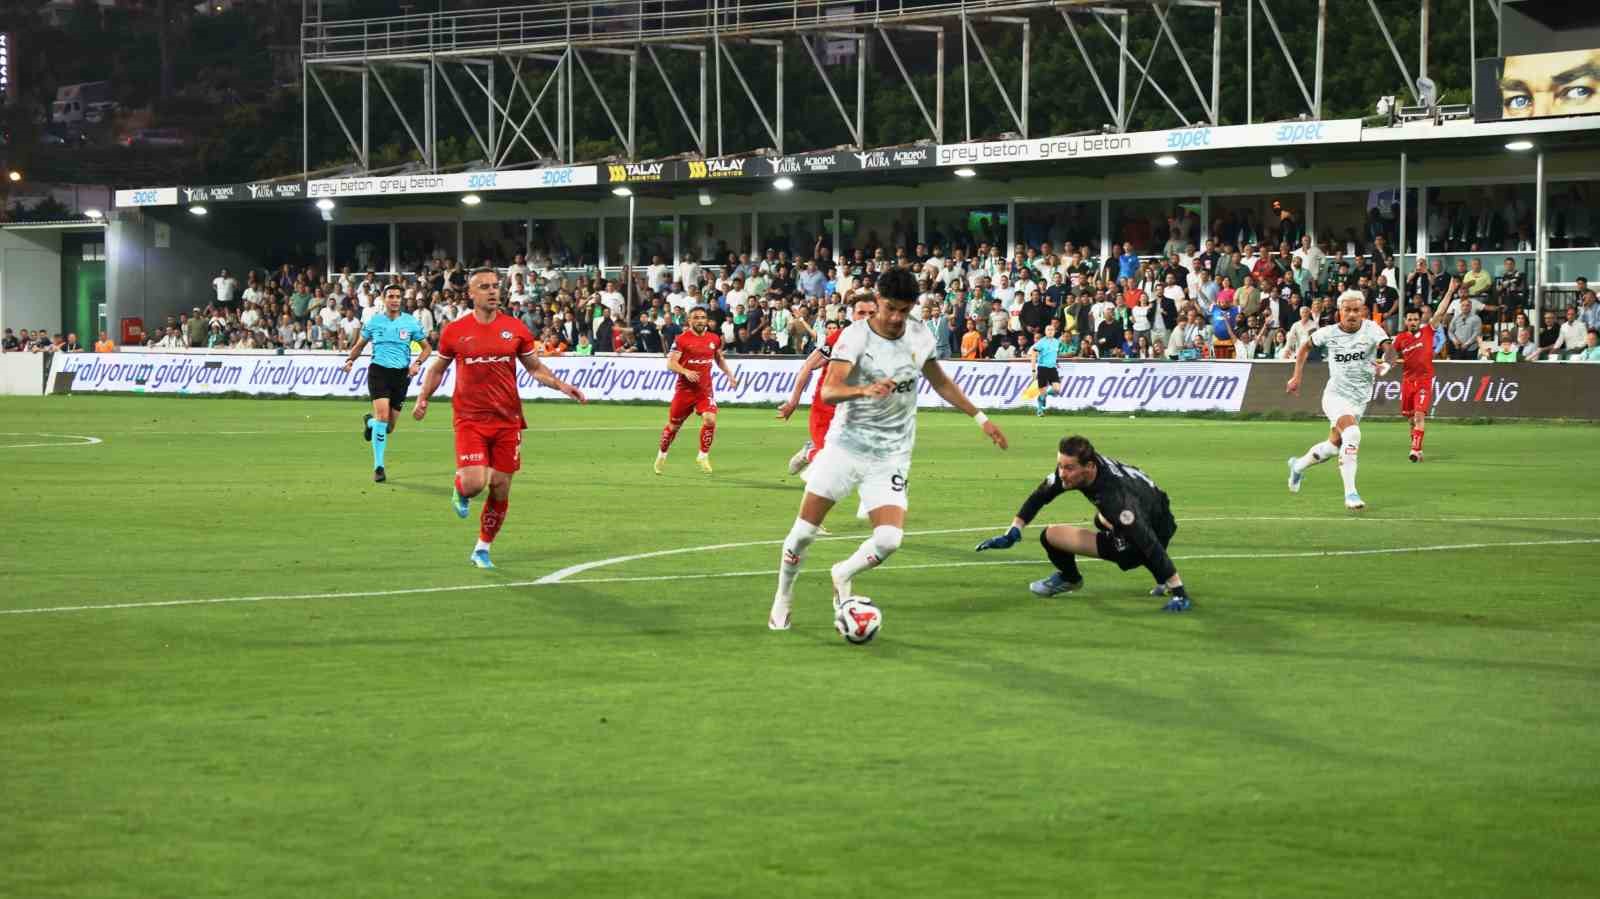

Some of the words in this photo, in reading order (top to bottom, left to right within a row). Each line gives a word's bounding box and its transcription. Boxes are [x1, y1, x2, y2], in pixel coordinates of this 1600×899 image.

[1167, 127, 1211, 149] opet
[1274, 122, 1323, 143] opet
[941, 146, 977, 163] grey
[983, 143, 1028, 158] beton
[1040, 141, 1078, 158] grey
[1083, 136, 1131, 151] beton
[625, 163, 663, 176] TALAY
[706, 159, 746, 171] TALAY
[780, 162, 801, 173] AURA
[867, 157, 890, 168] AURA
[311, 181, 337, 195] grey
[340, 178, 372, 192] beton
[379, 178, 407, 193] grey
[410, 176, 443, 190] beton
[152, 359, 242, 389] gidiyorum
[1093, 367, 1239, 406] gidiyorum
